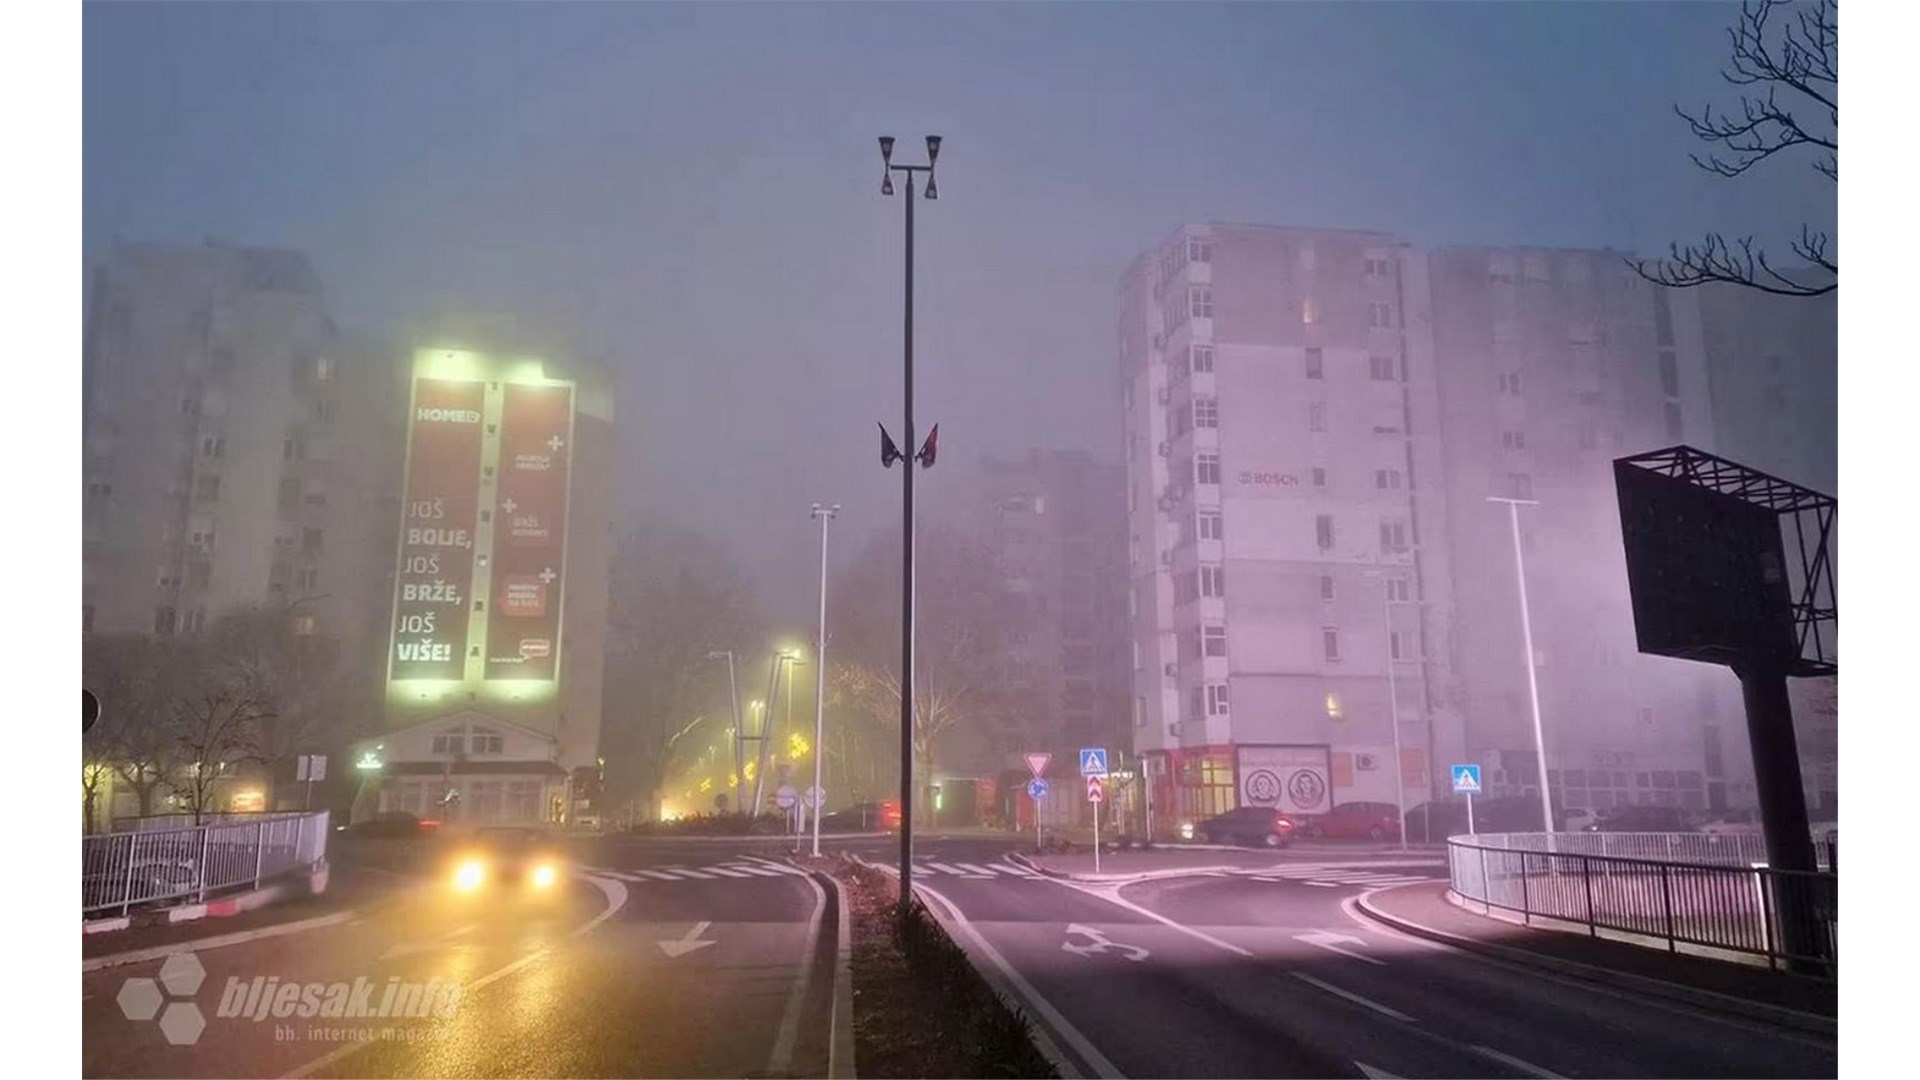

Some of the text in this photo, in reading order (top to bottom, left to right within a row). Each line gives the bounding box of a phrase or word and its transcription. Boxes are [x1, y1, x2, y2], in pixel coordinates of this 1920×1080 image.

[1254, 473, 1299, 486] BOSCH
[407, 498, 443, 519] JOŠ
[404, 553, 439, 574] JOŠ
[403, 579, 462, 605] BRŽE,
[398, 611, 434, 633] JOŠ
[397, 638, 451, 661] VIŠE!
